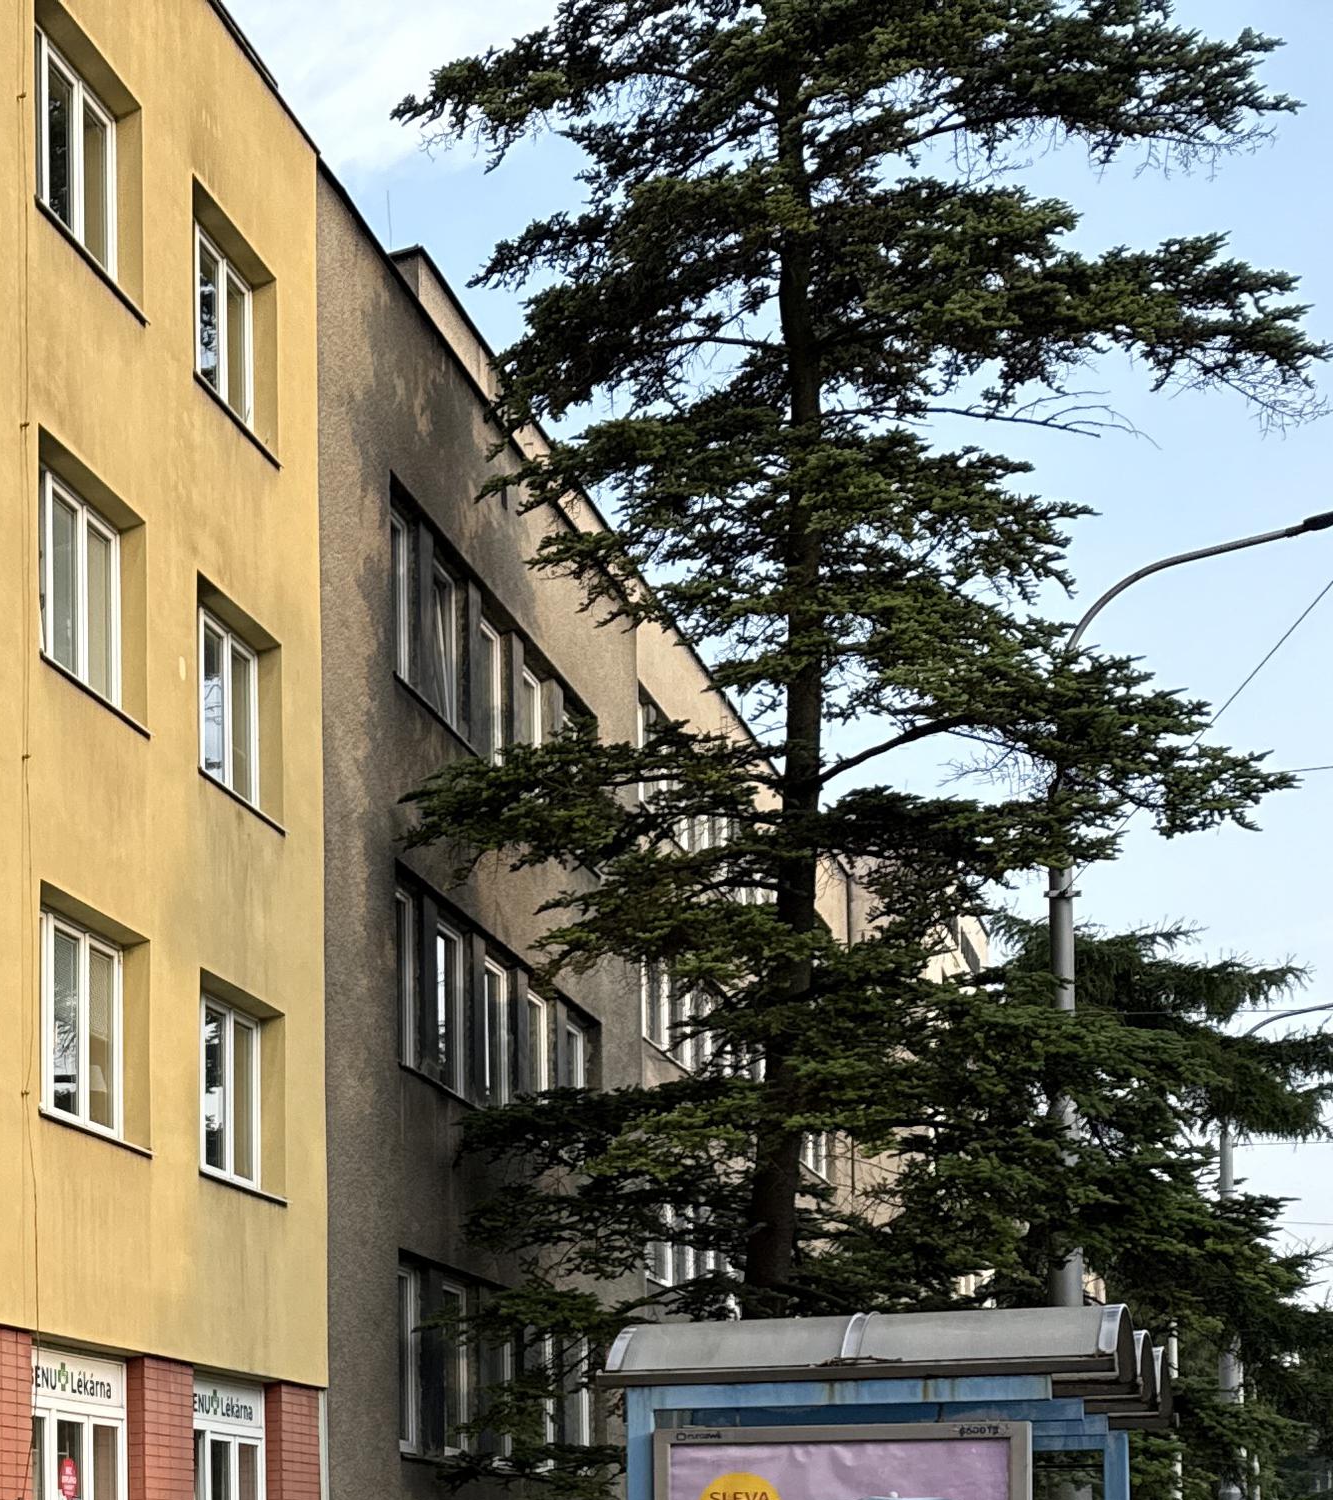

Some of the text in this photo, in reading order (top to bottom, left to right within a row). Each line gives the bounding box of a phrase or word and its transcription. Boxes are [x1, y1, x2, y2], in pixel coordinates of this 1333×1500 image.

[31, 1365, 112, 1399] ENU Lékárna
[192, 1393, 253, 1421] ENU Lékárna
